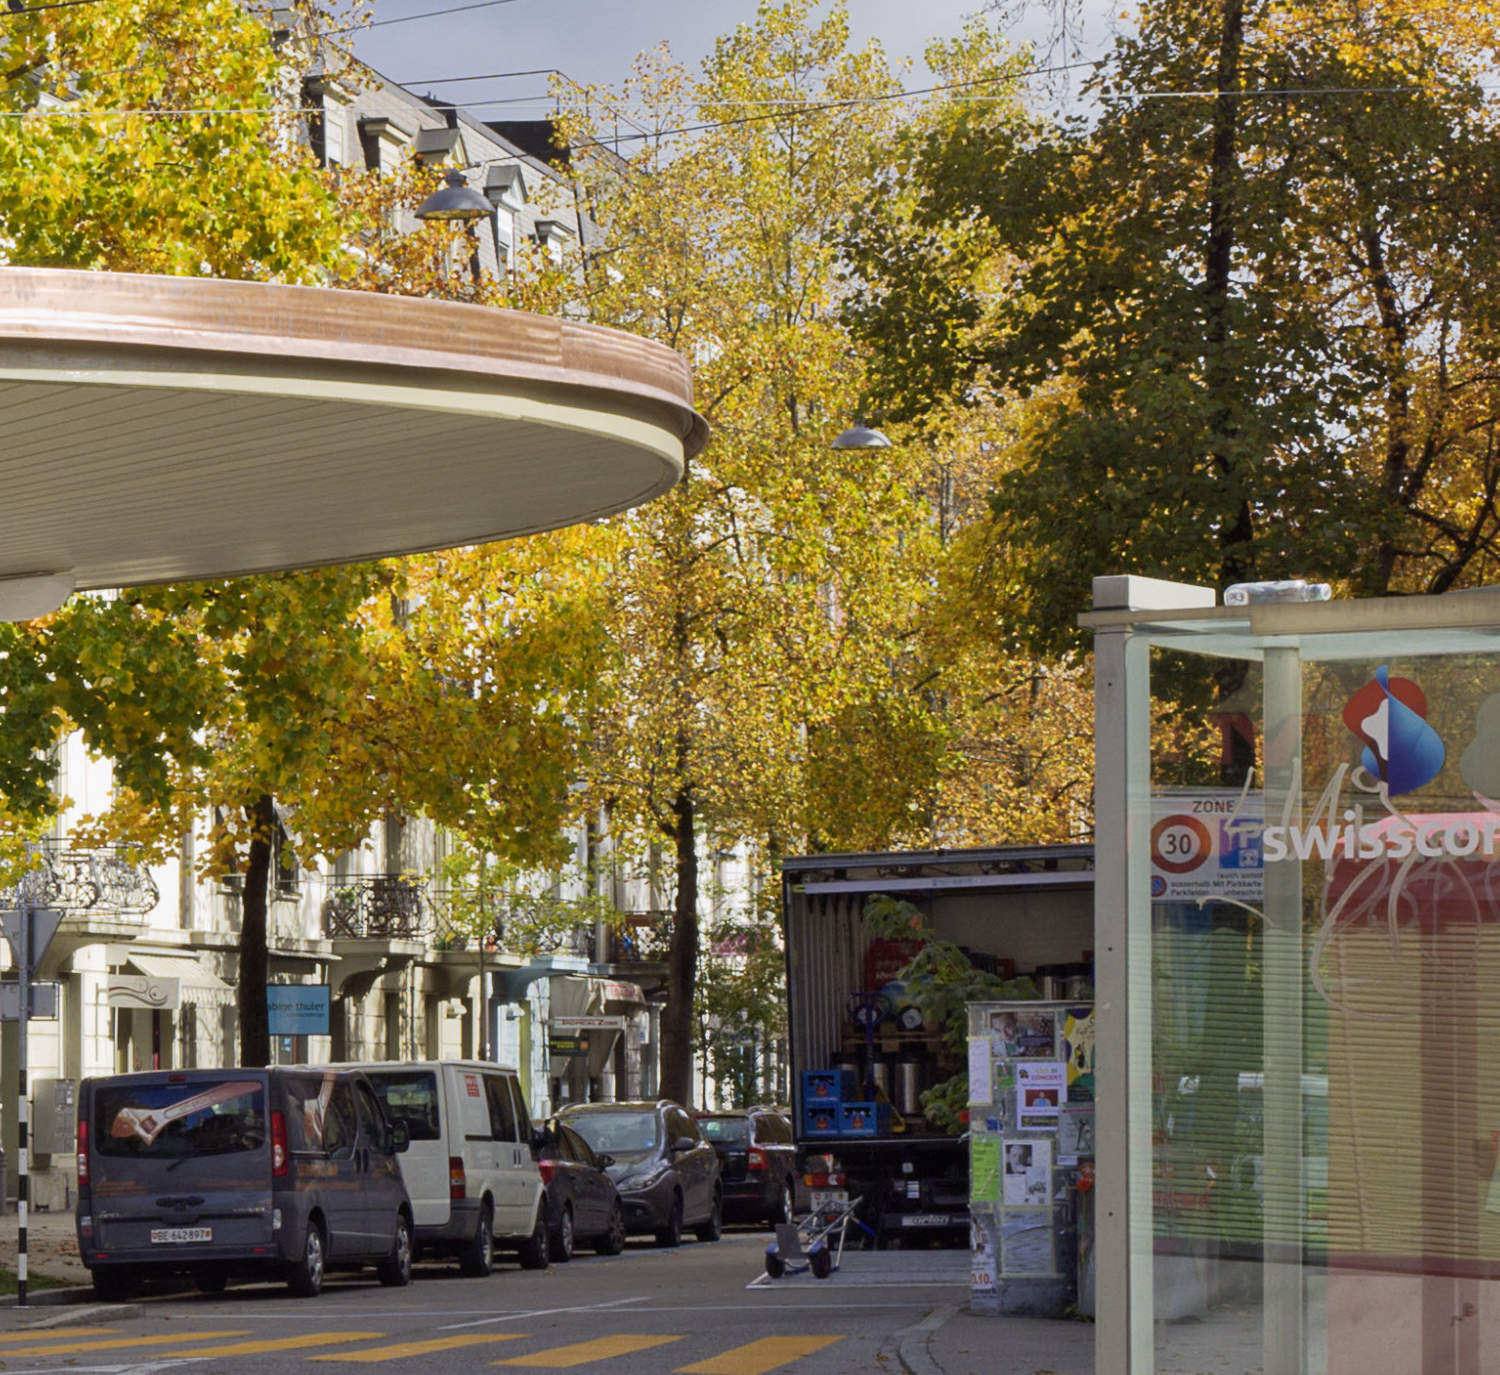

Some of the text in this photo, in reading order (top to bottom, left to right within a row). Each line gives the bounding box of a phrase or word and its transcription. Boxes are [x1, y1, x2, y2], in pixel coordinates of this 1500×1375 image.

[1192, 800, 1235, 814] ZONE
[1164, 833, 1192, 855] 30
[295, 1001, 326, 1012] thuler
